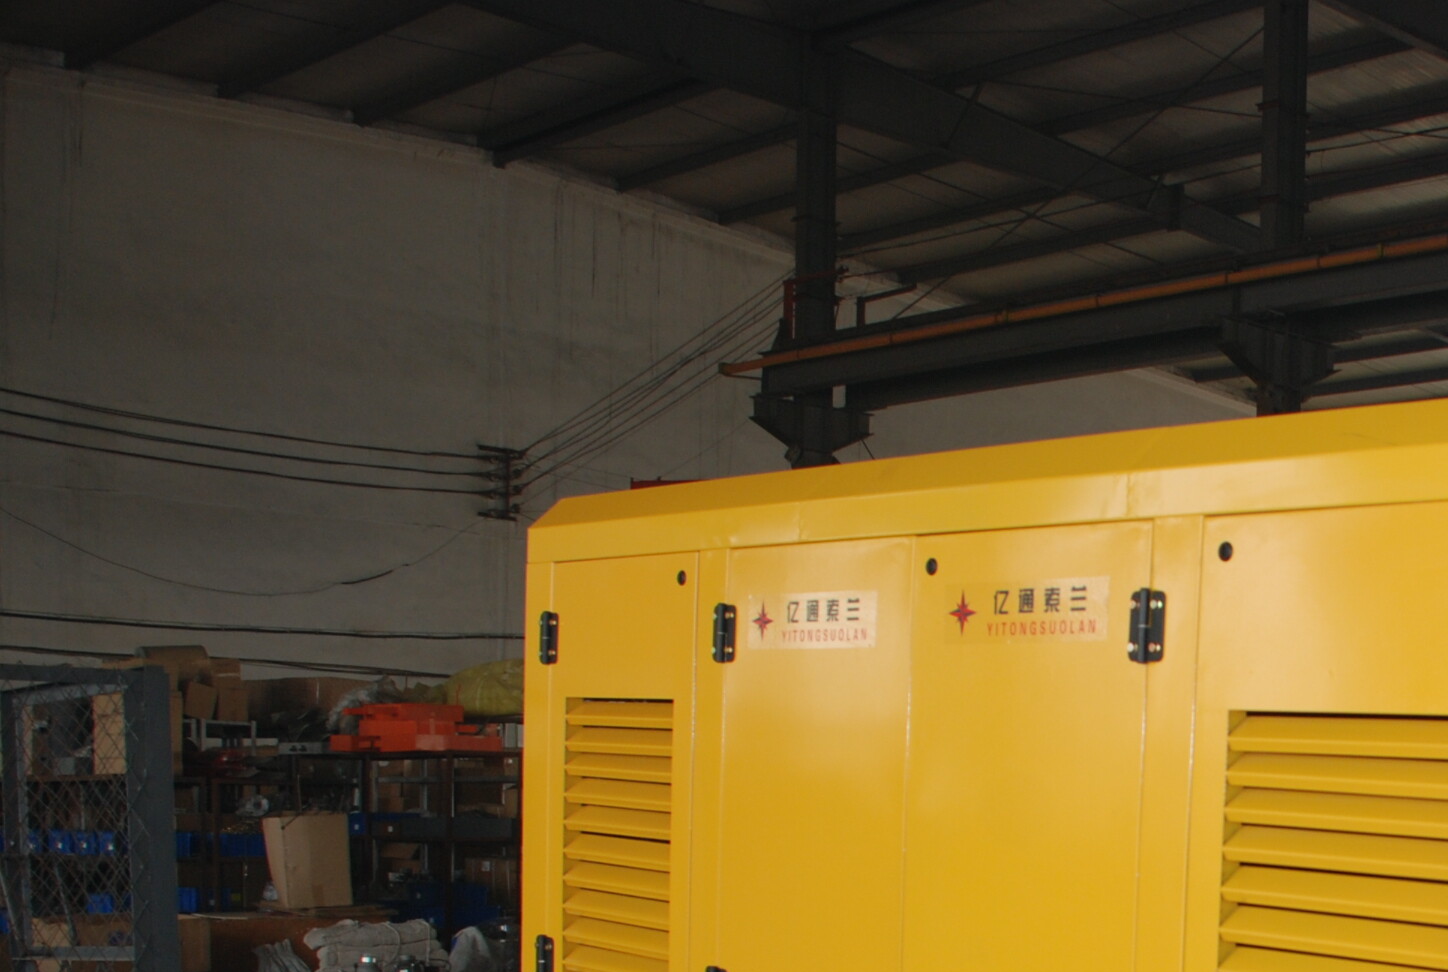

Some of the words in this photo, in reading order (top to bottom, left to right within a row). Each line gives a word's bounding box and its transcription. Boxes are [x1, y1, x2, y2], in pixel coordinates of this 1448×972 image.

[786, 598, 861, 624] 亿通索兰
[993, 586, 1088, 615] 亿通索兰
[781, 626, 868, 643] YITONGSUOLAN
[987, 618, 1097, 637] YITONGSUOLAN
